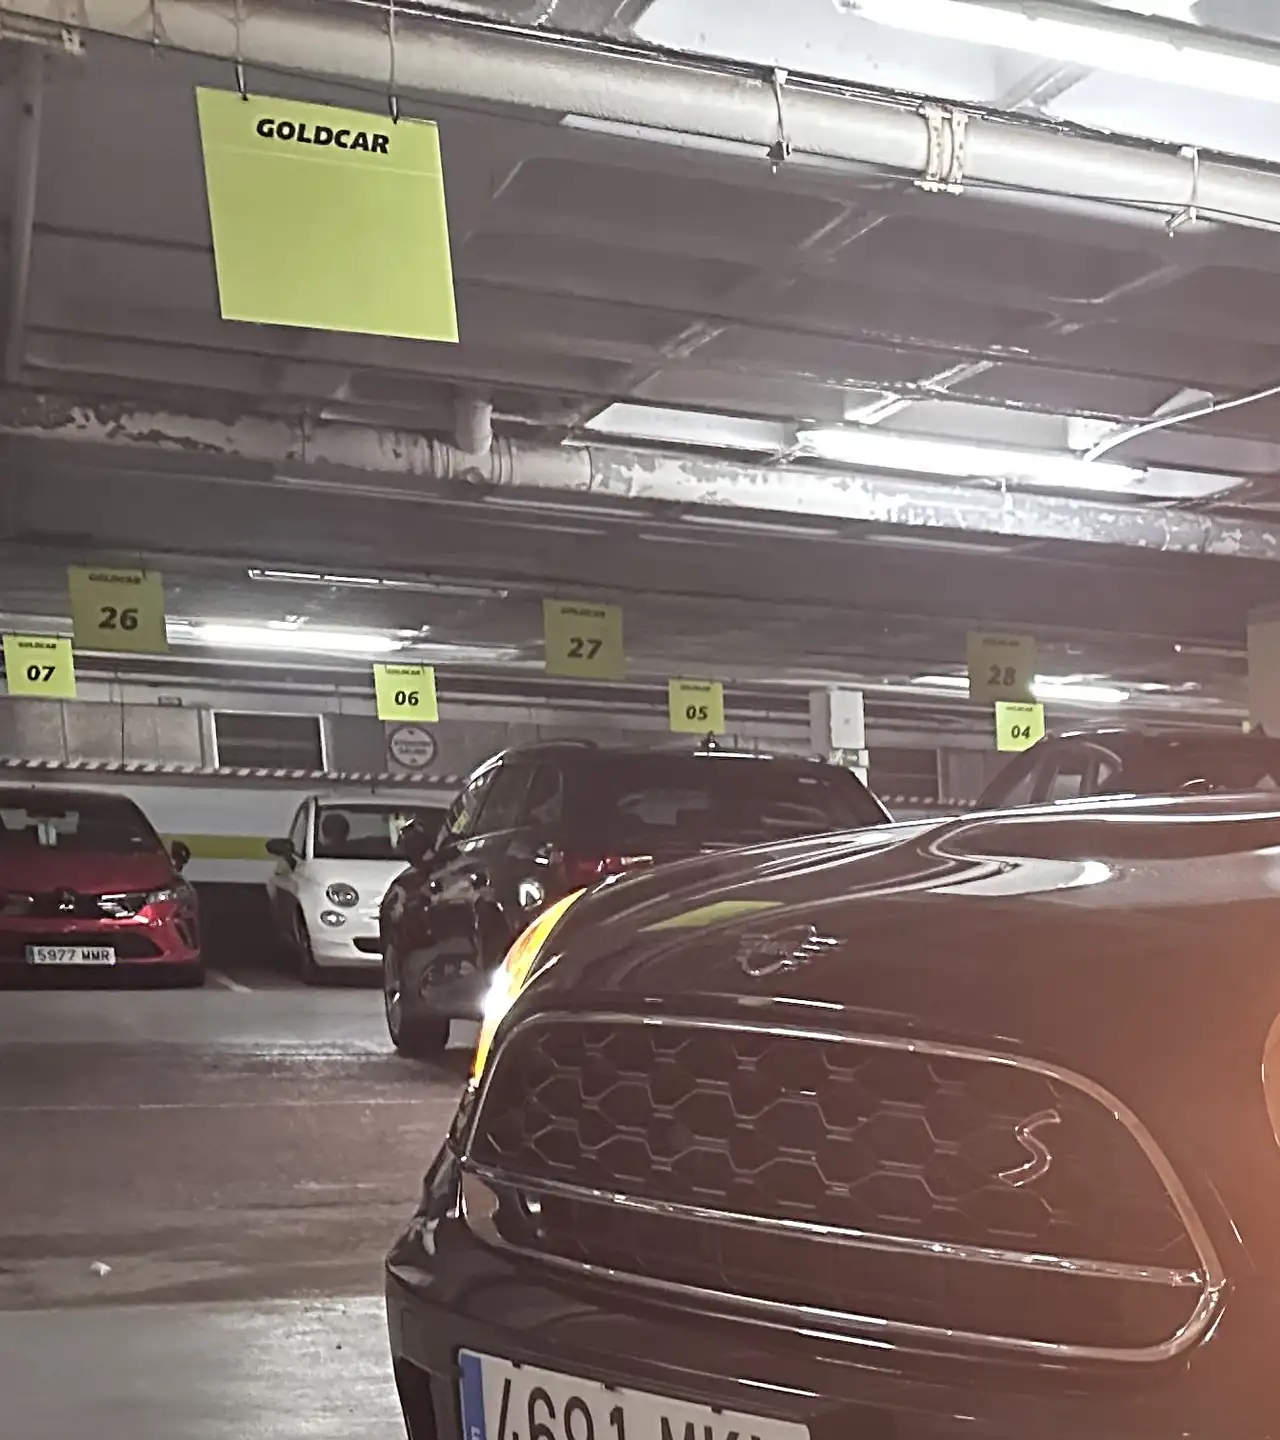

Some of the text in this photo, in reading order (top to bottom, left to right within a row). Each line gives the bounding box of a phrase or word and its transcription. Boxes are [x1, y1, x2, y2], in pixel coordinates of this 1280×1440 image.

[256, 118, 390, 154] GOLDCAR
[98, 605, 139, 631] 26
[566, 636, 603, 661] 27
[27, 664, 56, 682] 07
[987, 664, 1017, 687] 28
[394, 690, 420, 706] 06
[685, 704, 709, 721] 05
[1011, 724, 1031, 740] 04
